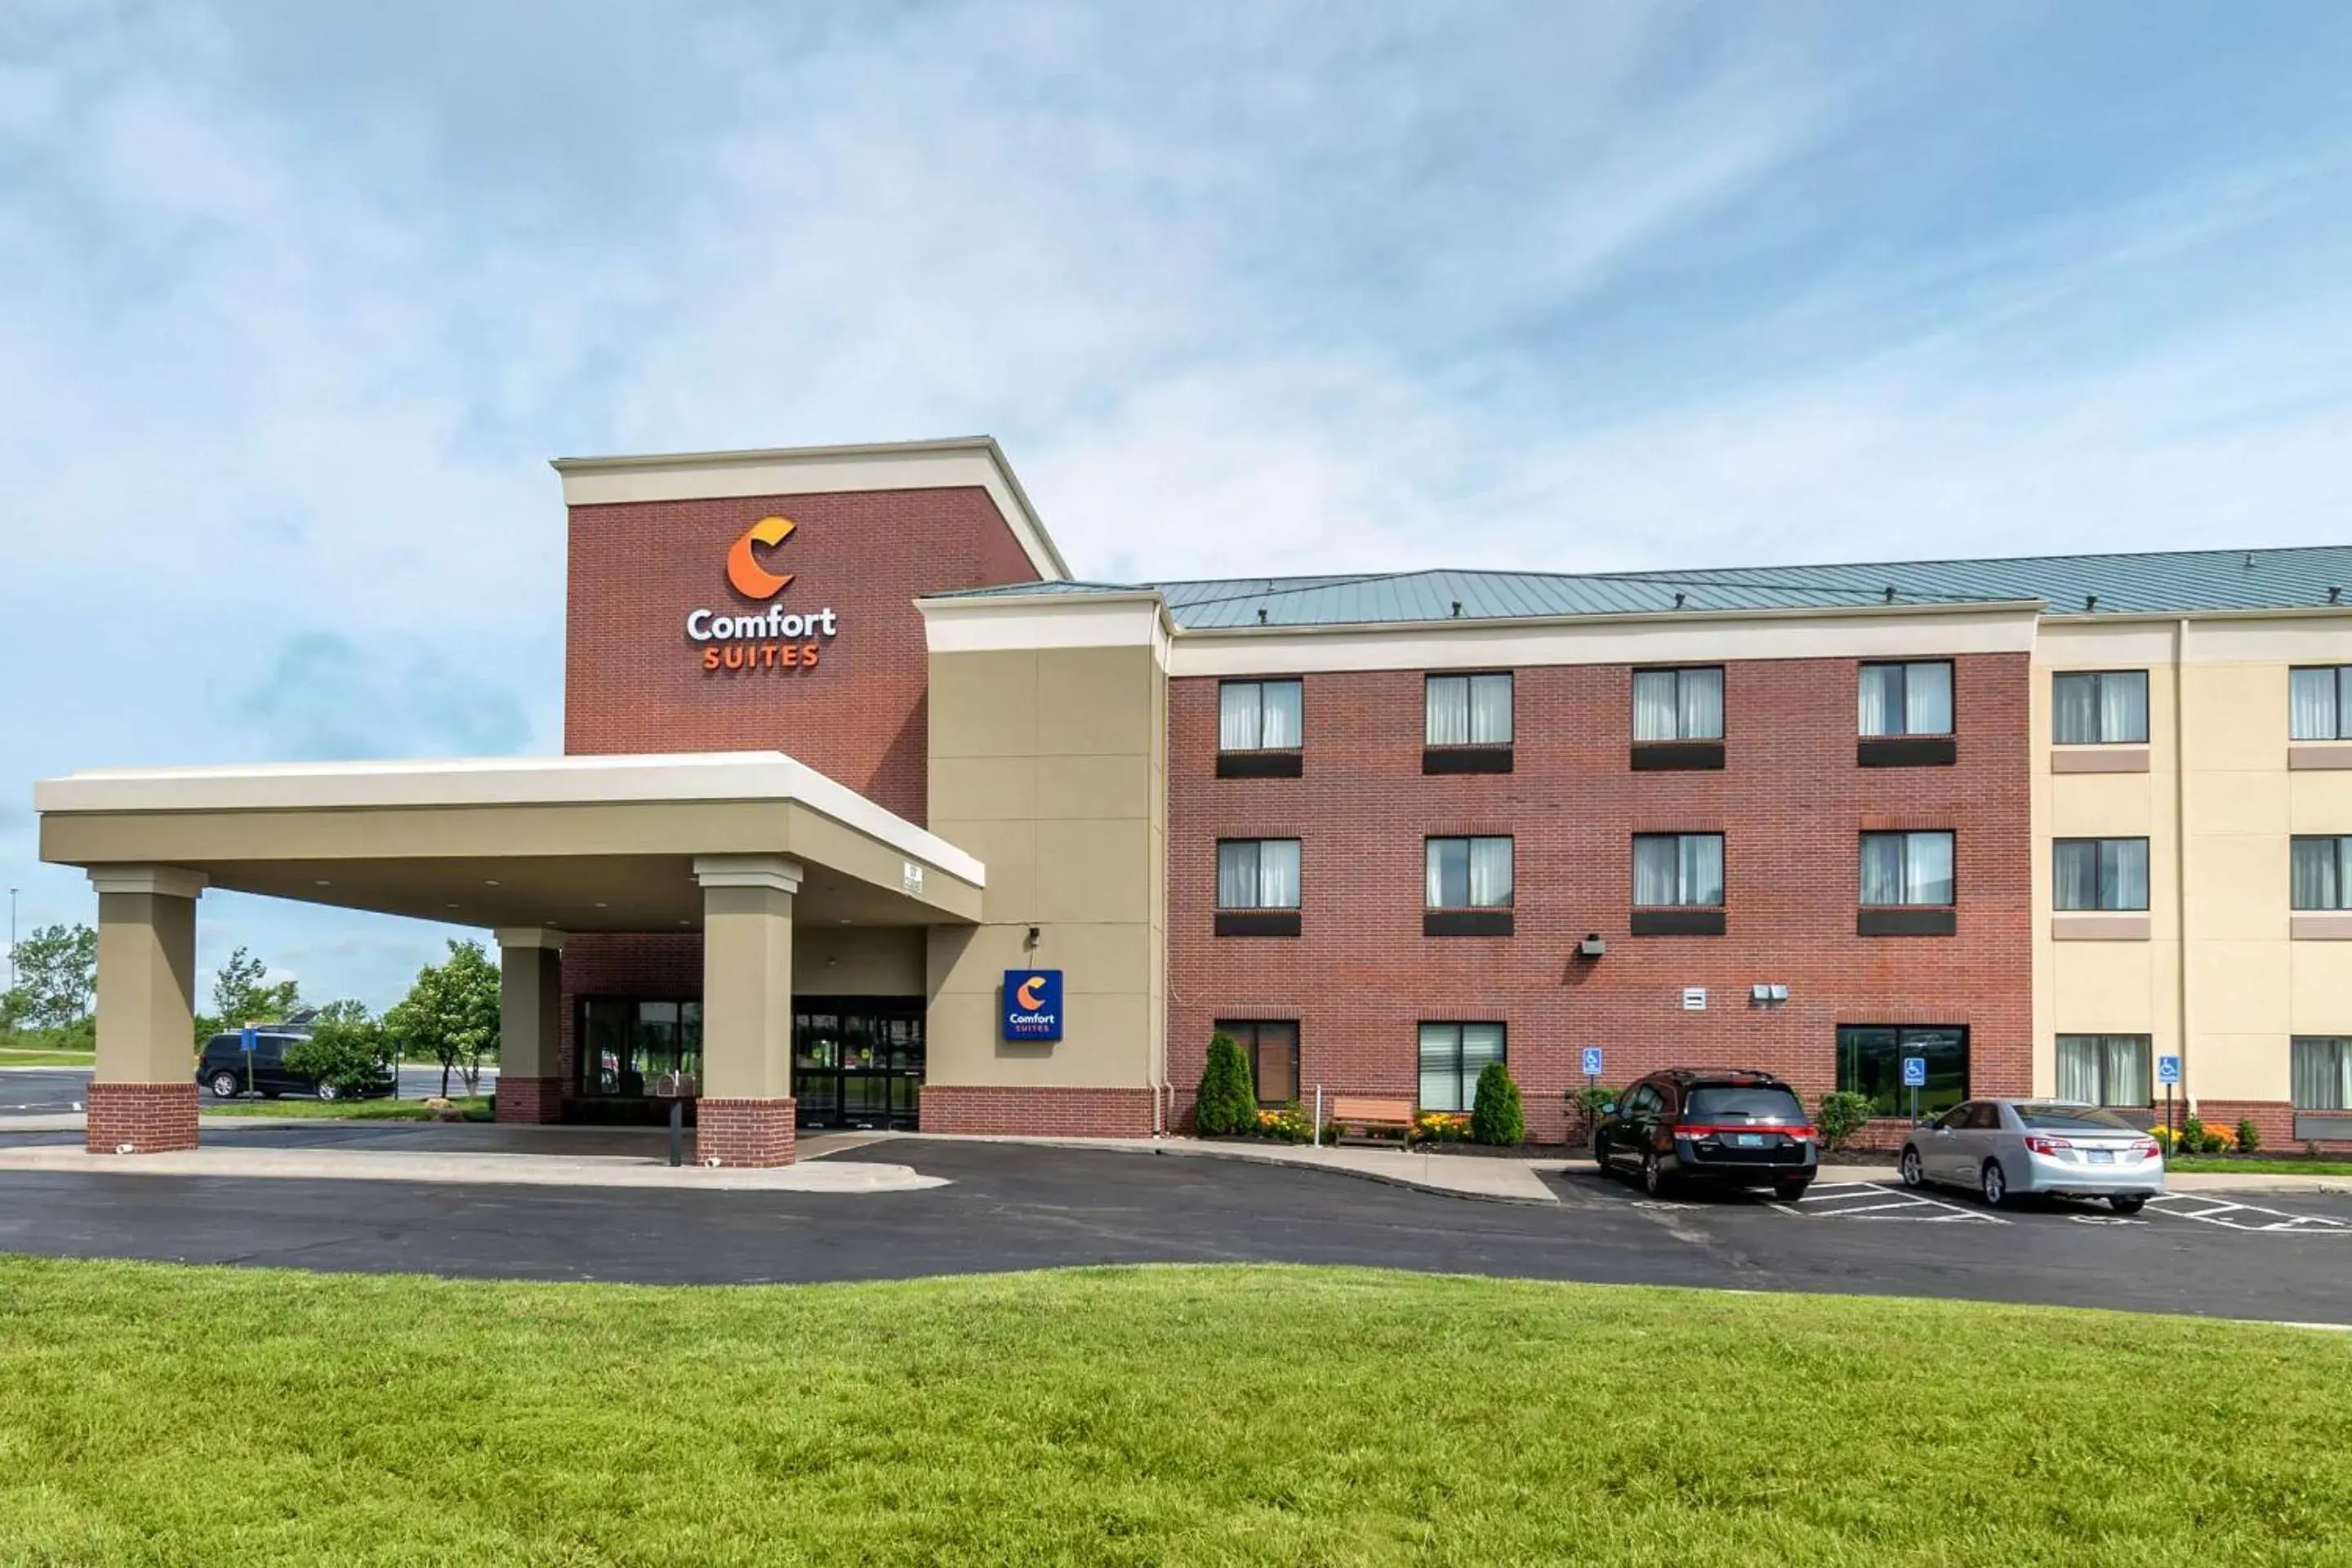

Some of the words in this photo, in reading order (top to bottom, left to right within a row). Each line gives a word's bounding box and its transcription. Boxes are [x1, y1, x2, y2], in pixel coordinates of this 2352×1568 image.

[687, 604, 836, 640] Comfort
[704, 645, 819, 670] SUITES
[1009, 1013, 1054, 1023] Comfort
